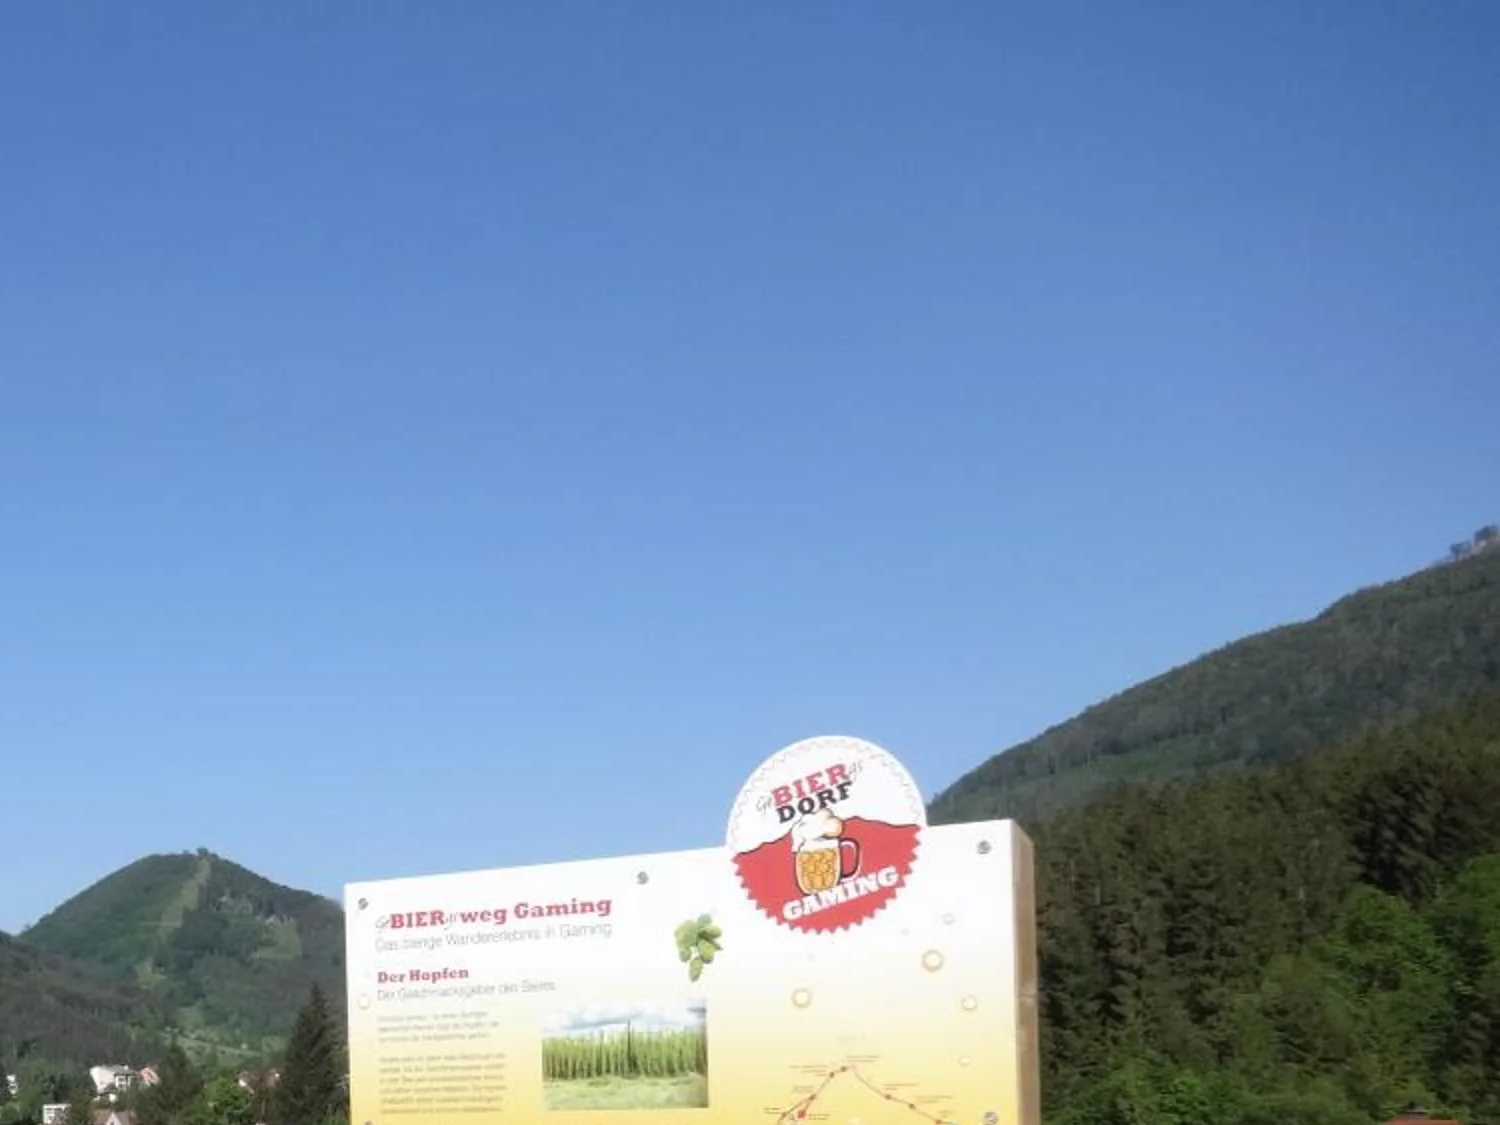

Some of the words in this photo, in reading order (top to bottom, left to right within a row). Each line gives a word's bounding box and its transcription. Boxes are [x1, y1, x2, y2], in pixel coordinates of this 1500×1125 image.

[777, 782, 852, 823] DORF
[782, 866, 900, 920] GAMING
[514, 897, 612, 919] Gaming
[559, 923, 612, 939] Gaming
[377, 971, 406, 984] Der
[409, 967, 469, 984] Hopfen
